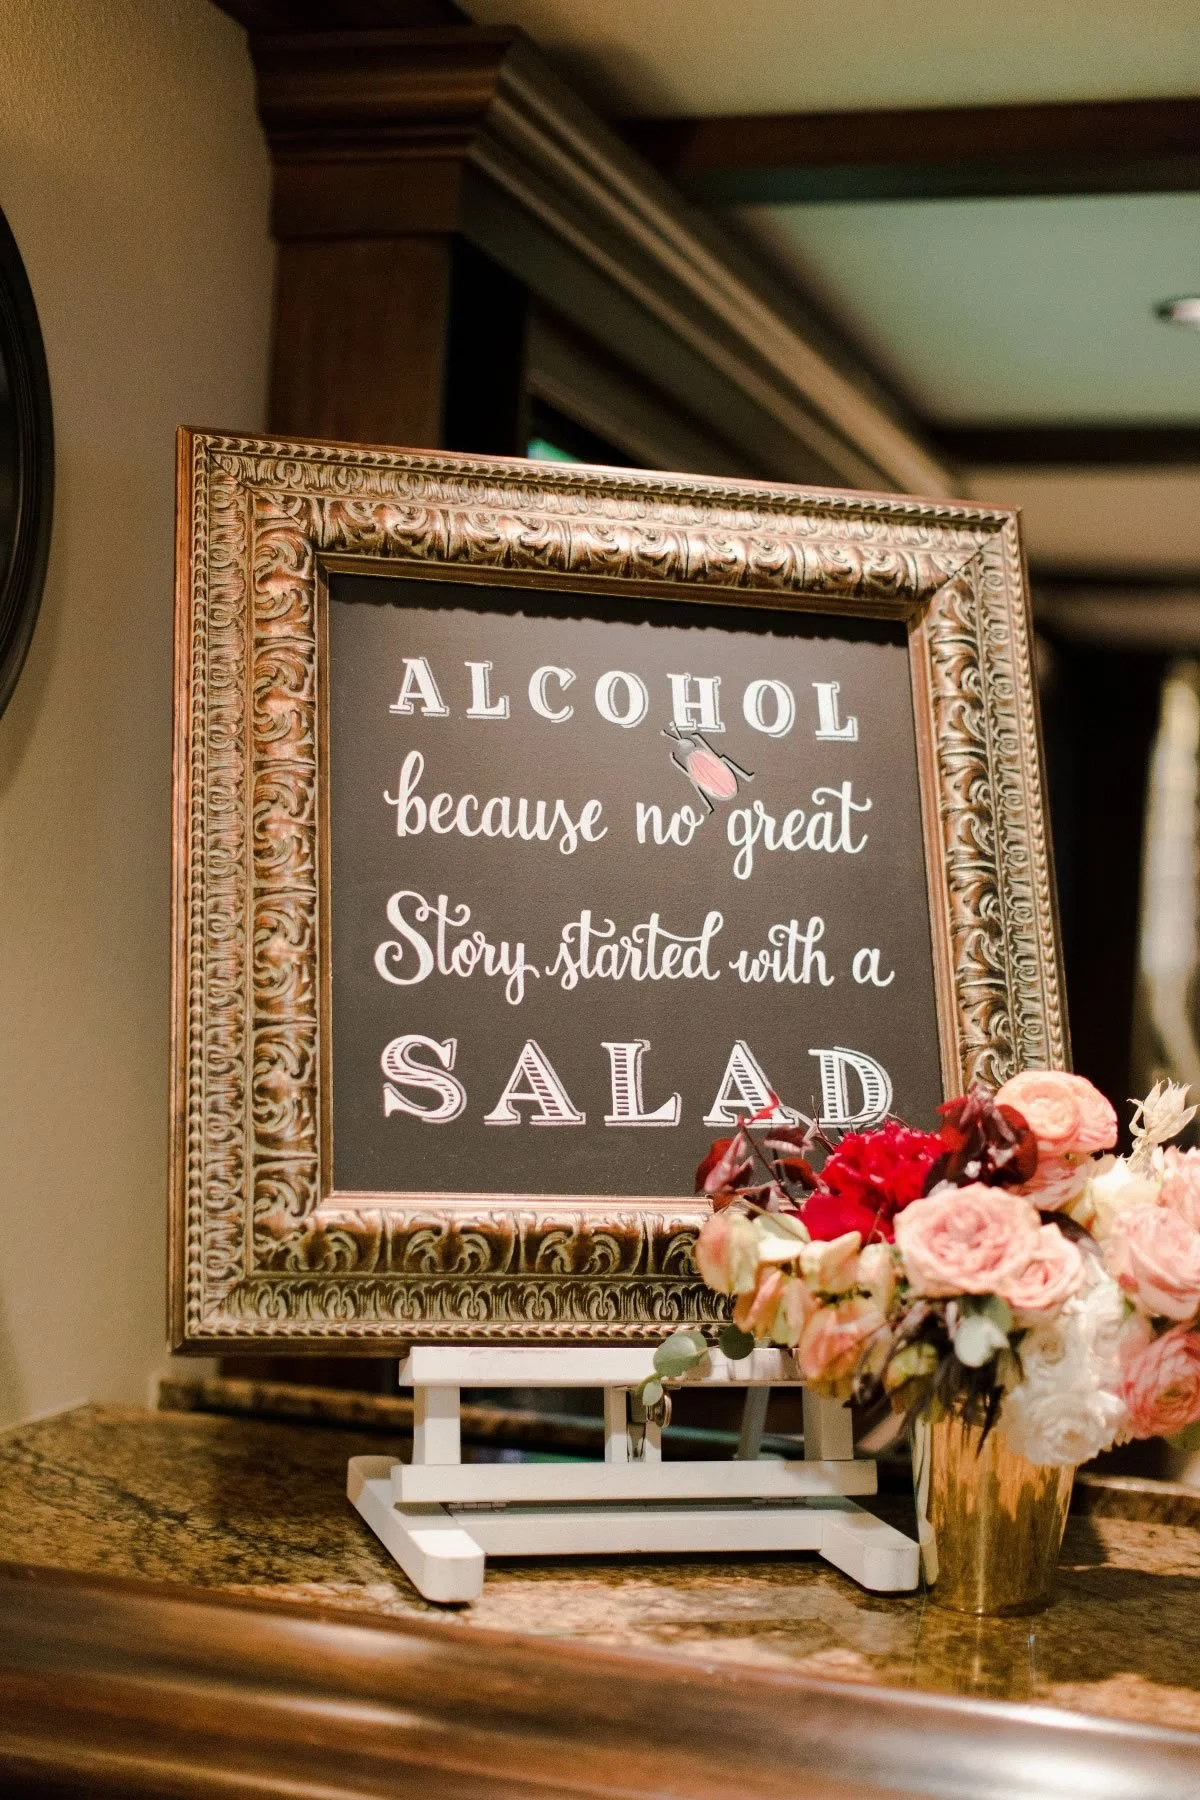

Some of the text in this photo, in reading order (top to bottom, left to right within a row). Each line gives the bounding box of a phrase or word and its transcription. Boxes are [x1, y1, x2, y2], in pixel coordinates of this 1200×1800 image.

[389, 656, 858, 742] ALCOHOL
[384, 750, 872, 880] because no great
[374, 889, 895, 1005] Story started with a
[381, 1033, 893, 1129] SALAD
